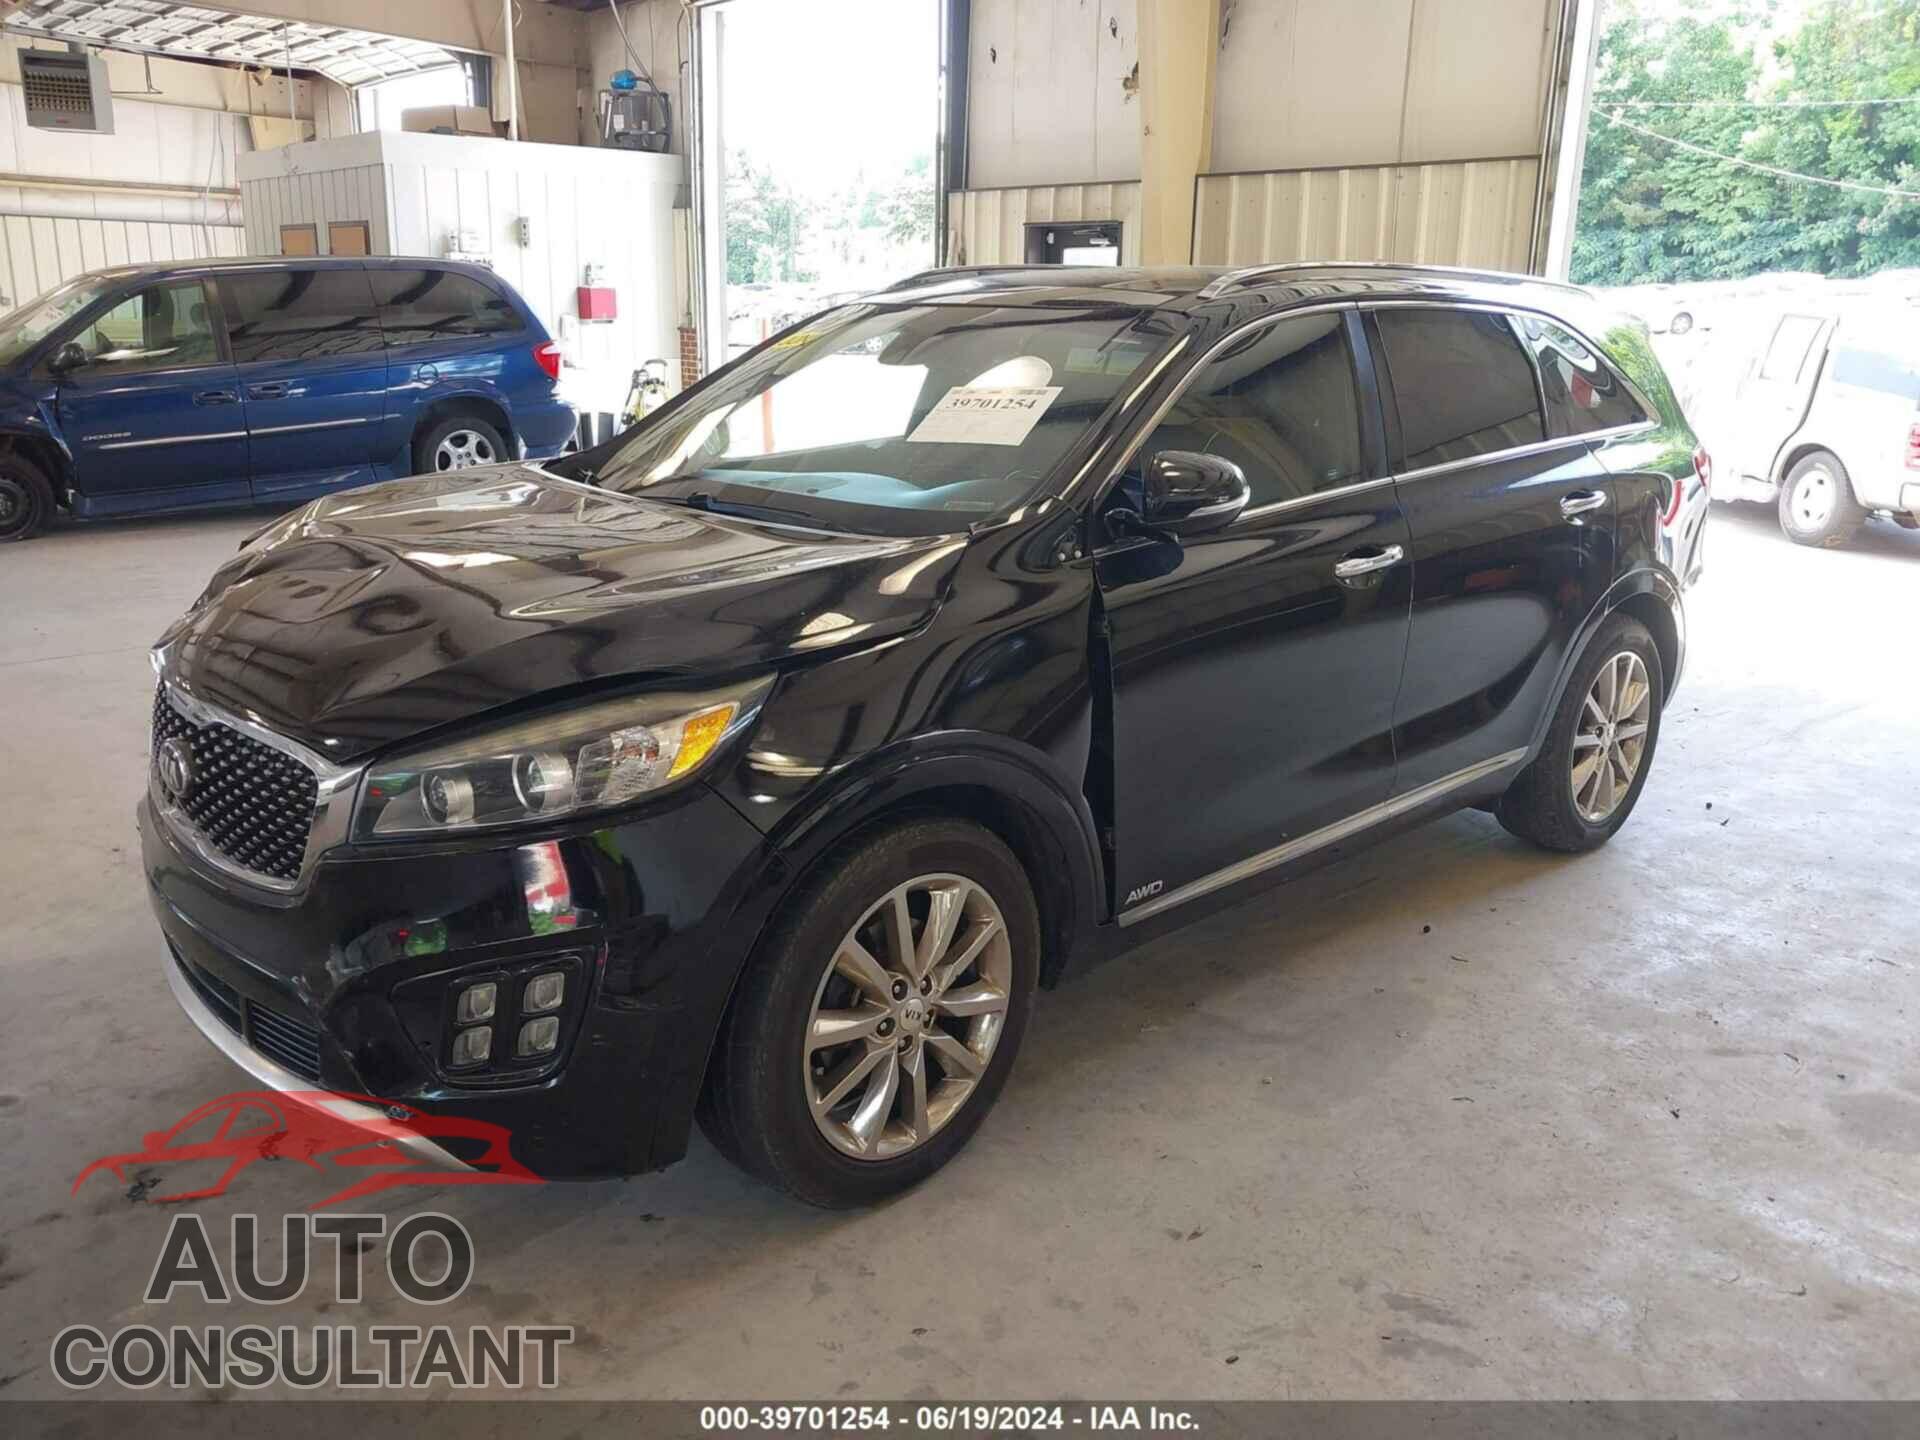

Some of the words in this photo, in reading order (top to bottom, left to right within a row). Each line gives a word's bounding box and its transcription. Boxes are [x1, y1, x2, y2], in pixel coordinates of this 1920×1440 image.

[945, 398, 1038, 410] 39701254
[1125, 880, 1163, 904] AWD
[905, 1008, 921, 1020] KIA
